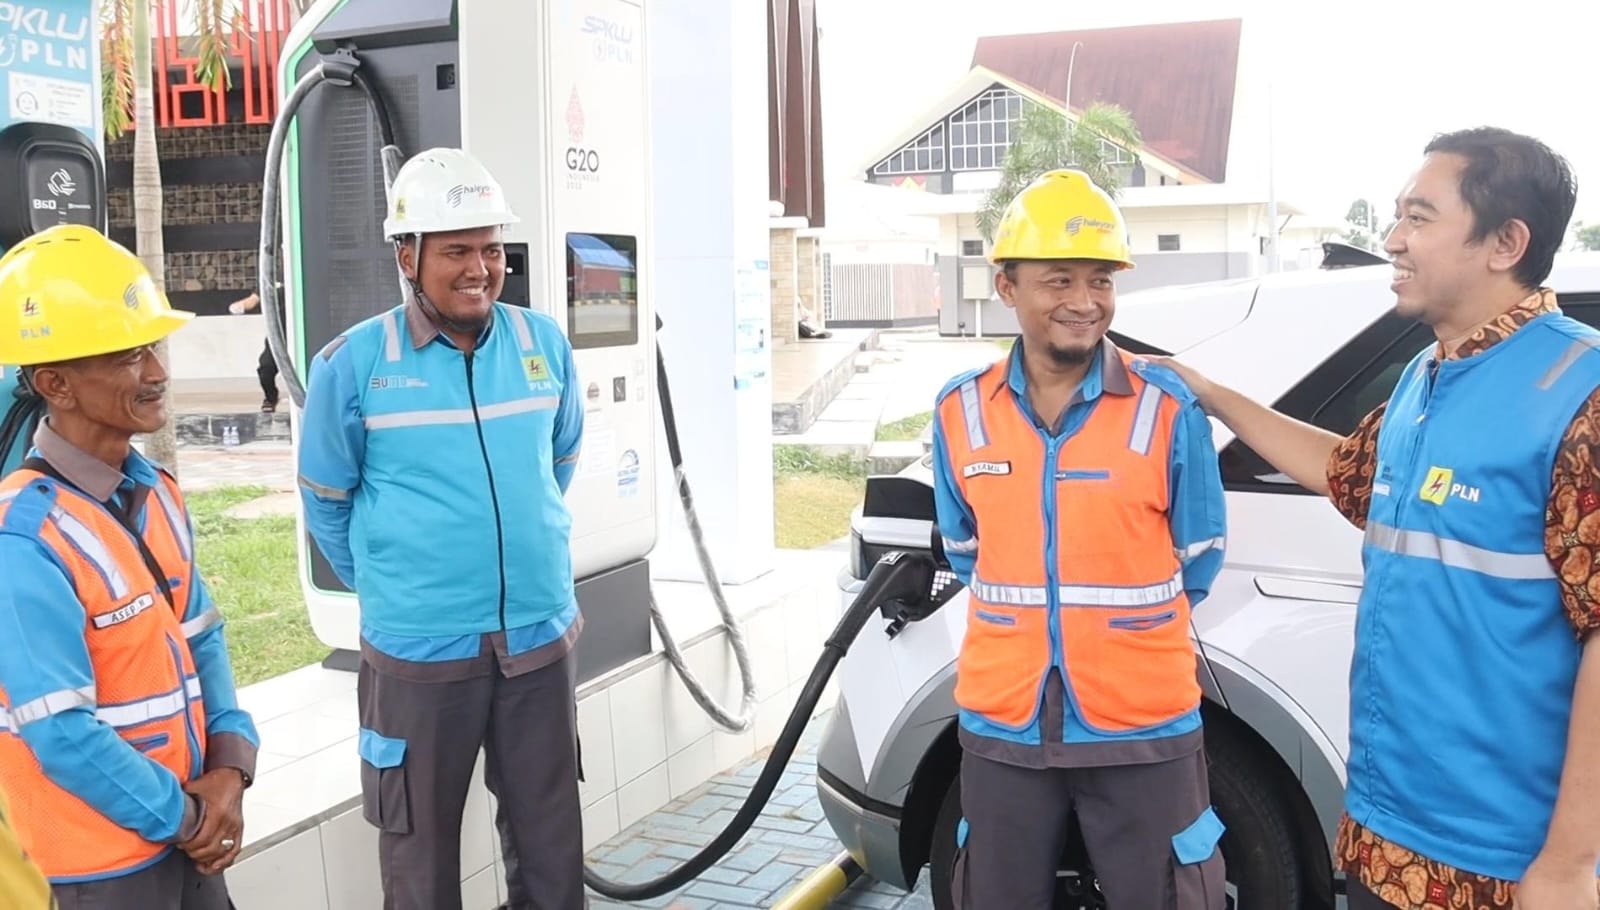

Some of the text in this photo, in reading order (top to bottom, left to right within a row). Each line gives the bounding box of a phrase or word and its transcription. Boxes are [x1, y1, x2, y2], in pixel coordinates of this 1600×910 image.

[0, 2, 88, 41] PKLU
[21, 38, 87, 70] PLN
[566, 147, 600, 173] G20
[20, 326, 51, 341] PLN
[528, 380, 553, 391] PLN
[1450, 483, 1480, 502] PLN
[112, 605, 135, 622] ASEP
